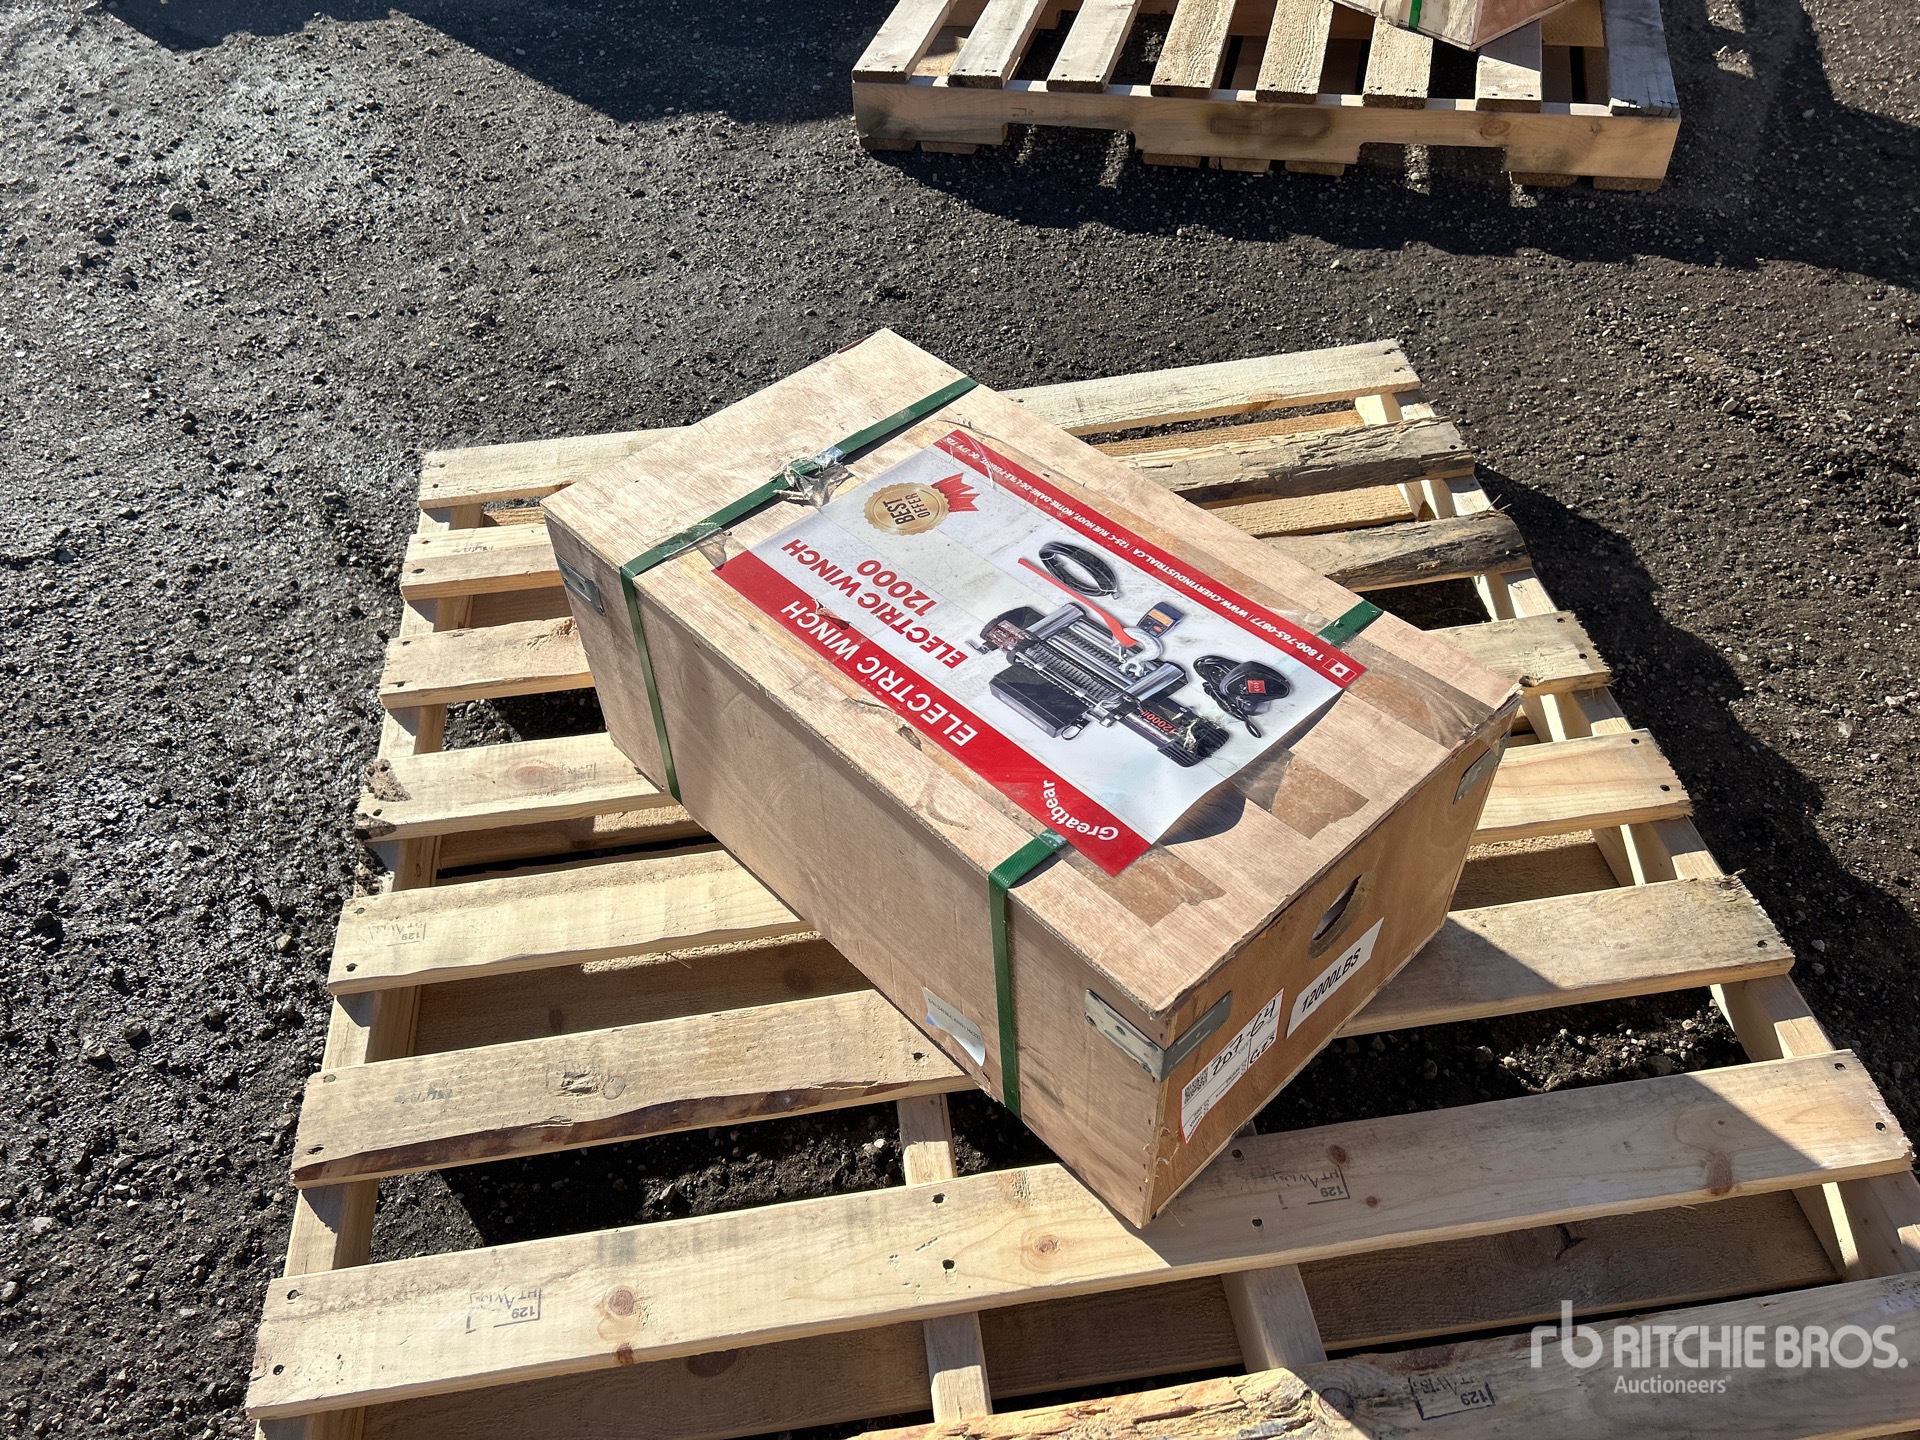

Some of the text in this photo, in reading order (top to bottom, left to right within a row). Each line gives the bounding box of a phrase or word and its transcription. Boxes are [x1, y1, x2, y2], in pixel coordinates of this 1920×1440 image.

[882, 498, 915, 524] BEST
[905, 492, 930, 517] OFFER
[1091, 524, 1110, 536] RUE
[1107, 534, 1129, 548] 125-C
[781, 537, 858, 597] WINCH
[1132, 547, 1248, 617] WWW.CHERYINDUSTRIAL.CA
[856, 557, 936, 616] 12000
[853, 587, 967, 669] ELECTRIC
[1250, 616, 1317, 656] 800-765-0877
[780, 598, 977, 747] ELECTRIC WINCH
[1042, 779, 1117, 842] Greatbear
[401, 931, 421, 941] 129
[1302, 947, 1361, 1012] 12000LBS
[1320, 1185, 1344, 1198] 129
[511, 1305, 536, 1319] 129
[1460, 1389, 1488, 1406] 129
